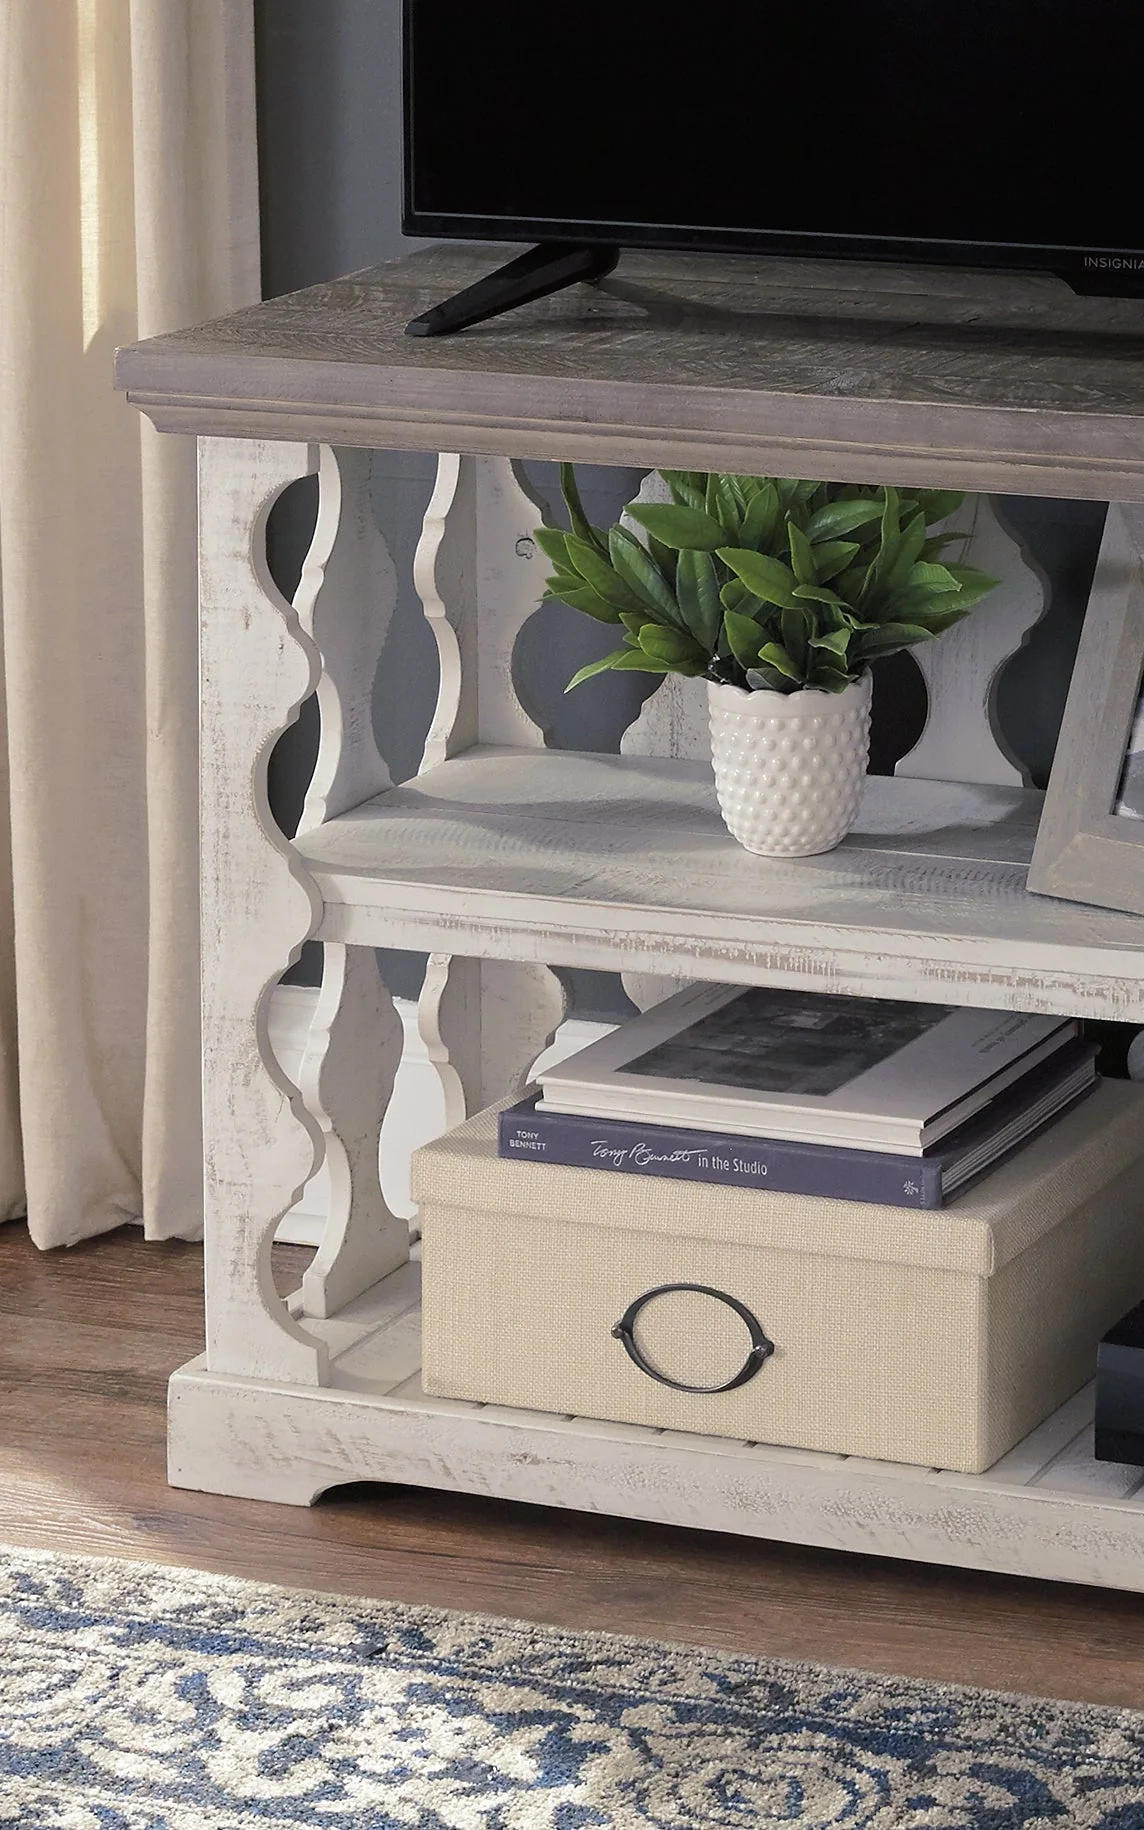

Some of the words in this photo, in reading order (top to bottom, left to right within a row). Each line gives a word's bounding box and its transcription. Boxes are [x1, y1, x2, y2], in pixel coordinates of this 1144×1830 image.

[516, 1130, 539, 1139] TONY
[509, 1139, 546, 1151] BENNETT
[591, 1140, 627, 1167] Tony
[697, 1154, 709, 1168] in
[712, 1156, 729, 1171] the
[733, 1158, 768, 1176] Studio
